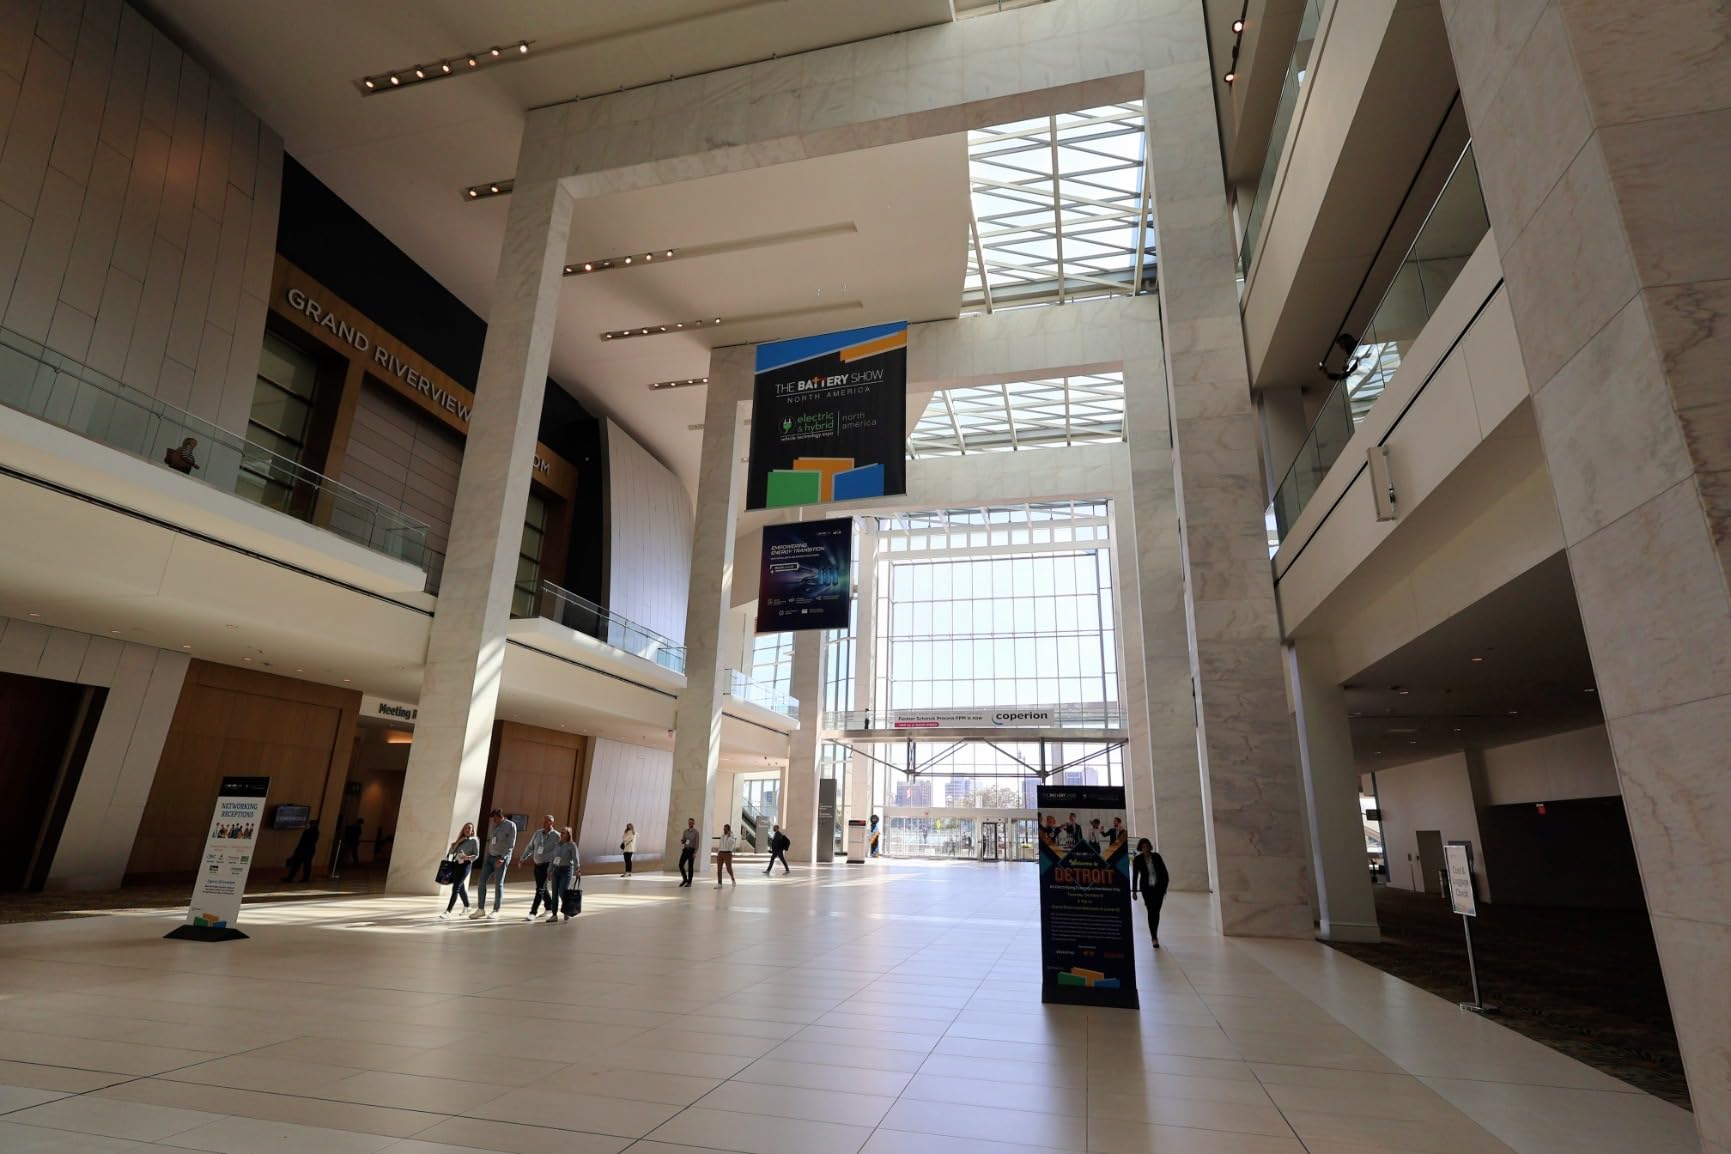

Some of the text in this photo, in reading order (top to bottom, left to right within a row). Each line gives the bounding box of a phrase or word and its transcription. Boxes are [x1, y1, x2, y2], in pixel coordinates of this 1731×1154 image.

[287, 288, 472, 422] GRAND RIVERVIEW
[776, 369, 884, 394] THE BATTERY SHOW
[787, 386, 871, 404] NORTH AMERICA
[797, 411, 865, 423] electric north
[804, 419, 834, 433] hybrid
[842, 419, 877, 430] america
[379, 703, 411, 720] Meeting
[995, 711, 1048, 722] coperion
[221, 802, 258, 810] NETWORKING
[1055, 867, 1115, 885] DETROIT
